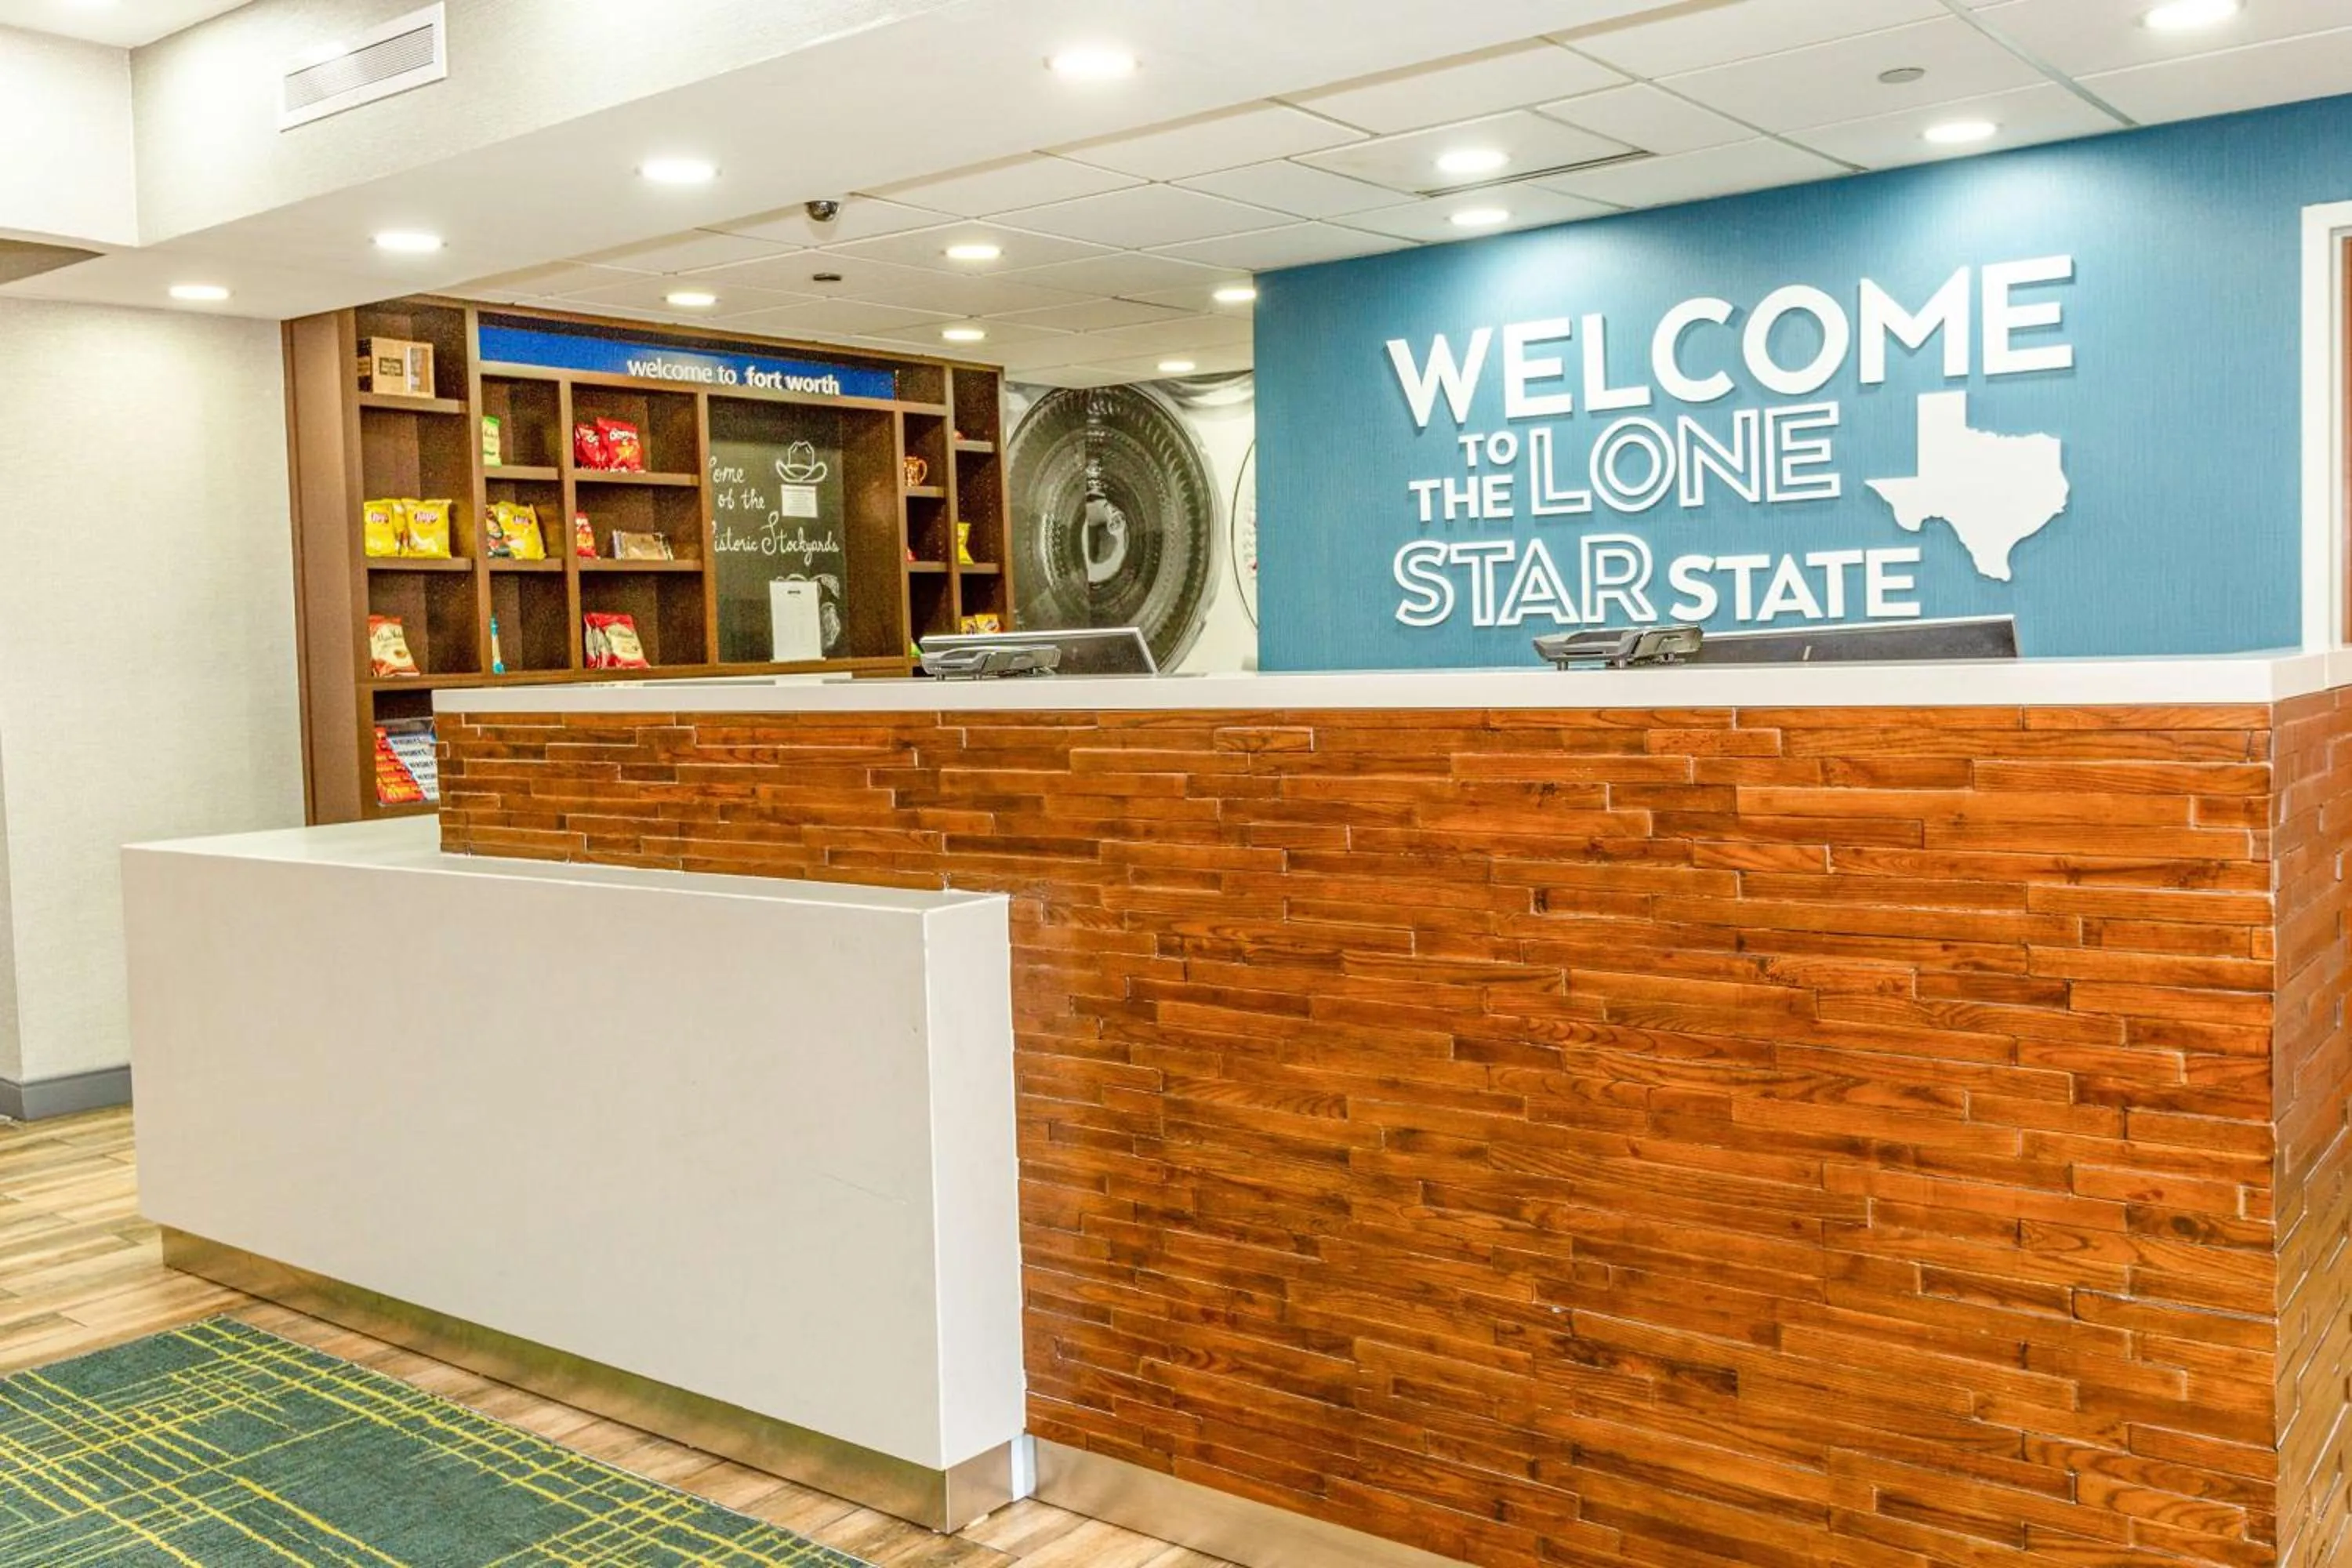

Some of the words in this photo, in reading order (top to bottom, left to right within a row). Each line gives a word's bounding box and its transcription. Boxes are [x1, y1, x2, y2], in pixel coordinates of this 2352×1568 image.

[1385, 255, 2074, 428] WELCOME
[627, 358, 713, 383] welcome
[717, 365, 737, 385] to
[744, 365, 782, 390] fort
[786, 374, 841, 395] worth
[1409, 474, 1515, 522] THE
[1529, 401, 1841, 516] LONE
[1457, 431, 1518, 468] TO
[717, 488, 735, 510] of
[740, 488, 766, 510] the
[712, 520, 759, 552] istoric
[760, 510, 840, 566] Stockyards
[1393, 533, 1657, 627] STAR
[1668, 547, 1922, 622] STATE
